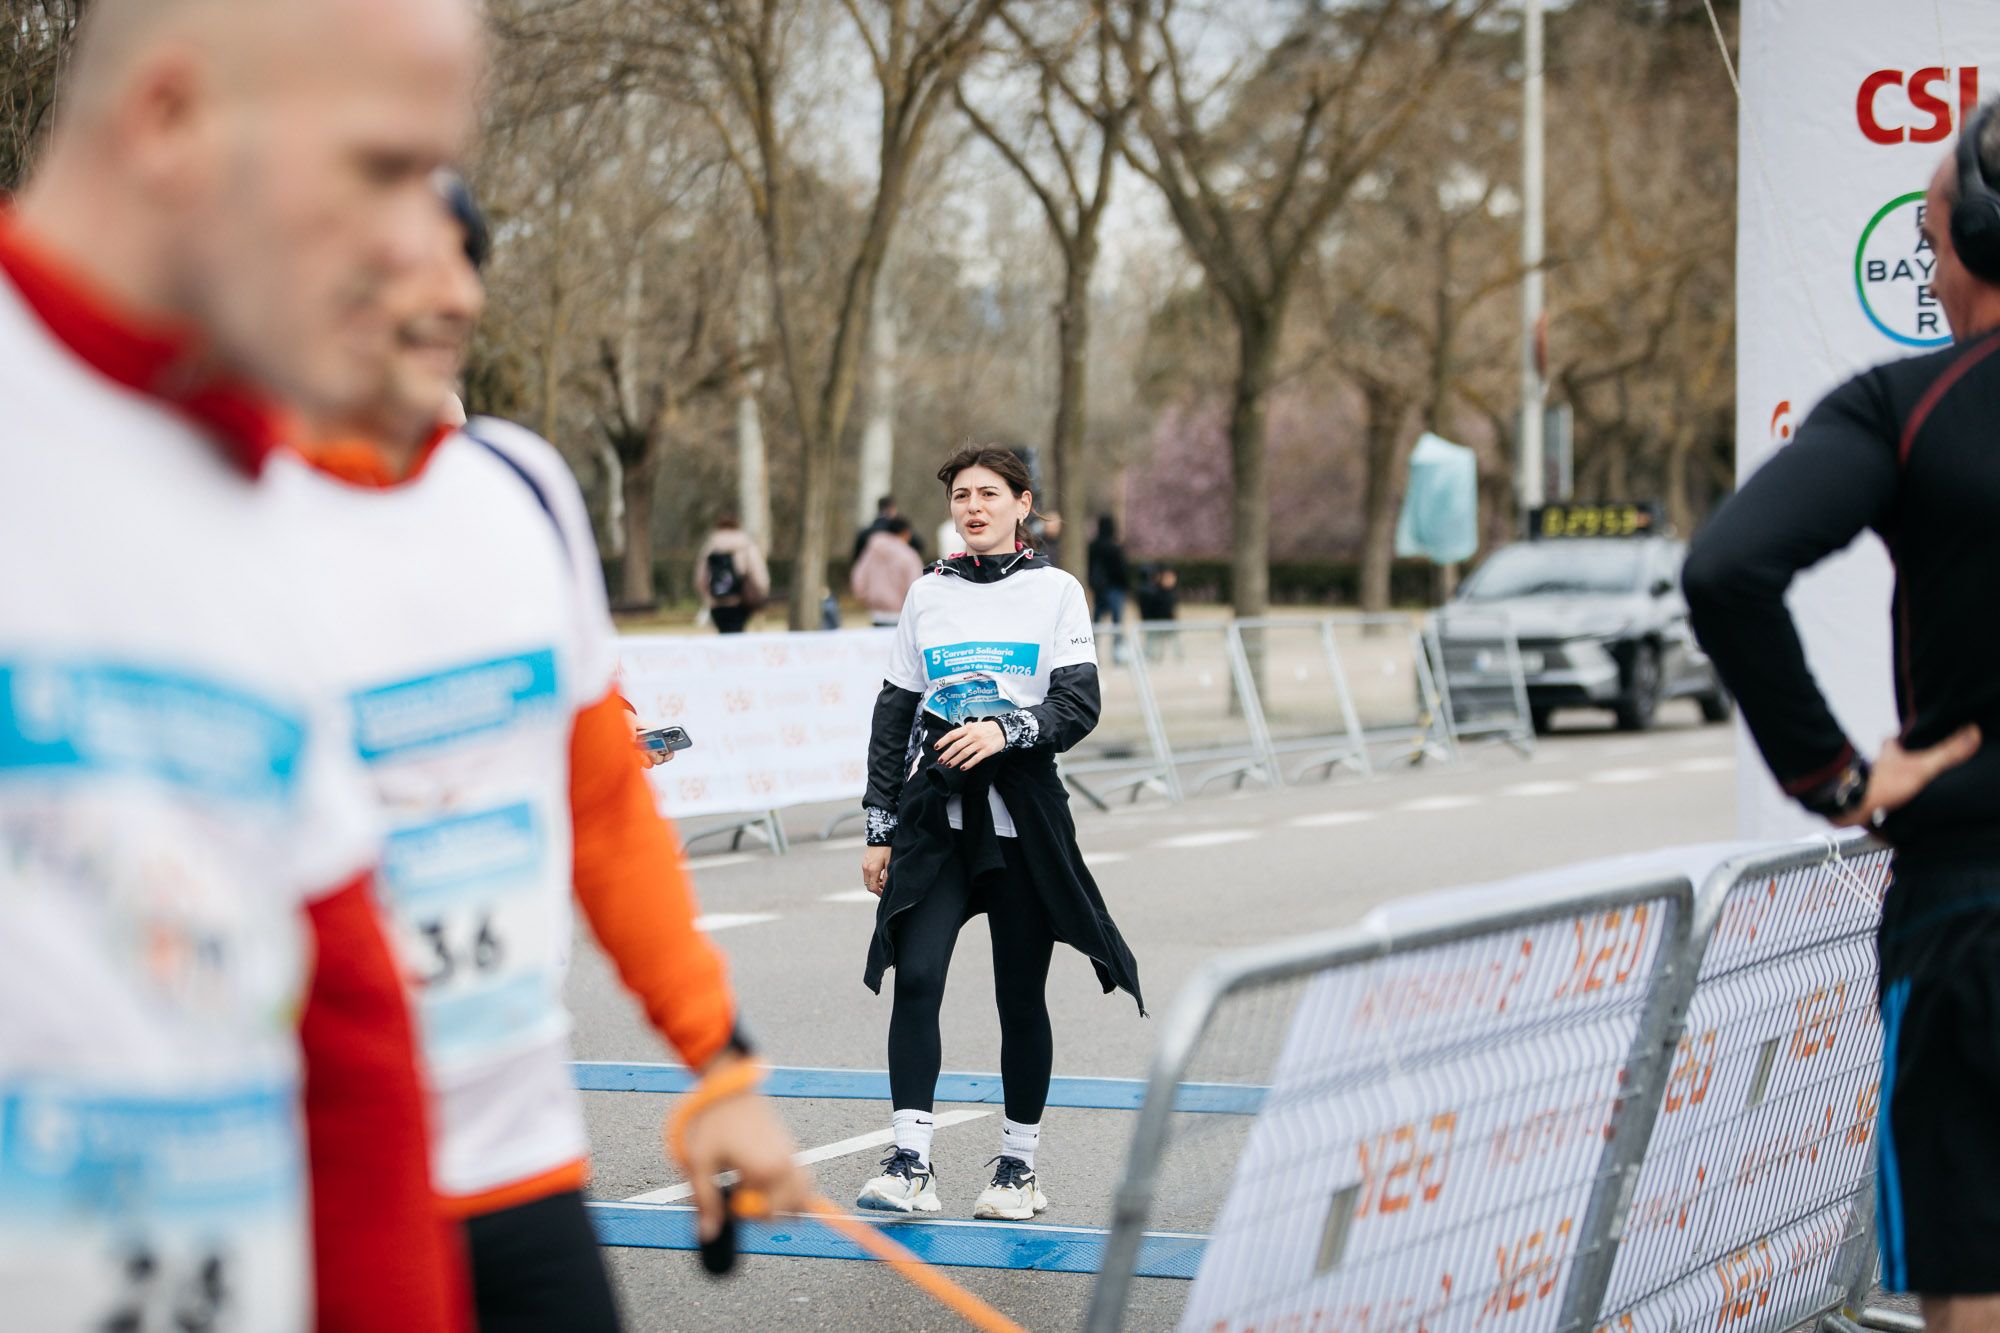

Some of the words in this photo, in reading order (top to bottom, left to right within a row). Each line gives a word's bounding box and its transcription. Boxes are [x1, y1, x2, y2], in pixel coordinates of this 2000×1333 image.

[1867, 258, 1937, 282] BAY
[942, 648, 974, 659] Carrera
[975, 646, 1014, 657] Solidaria
[1002, 663, 1033, 676] 2026
[967, 685, 998, 697] Solidari
